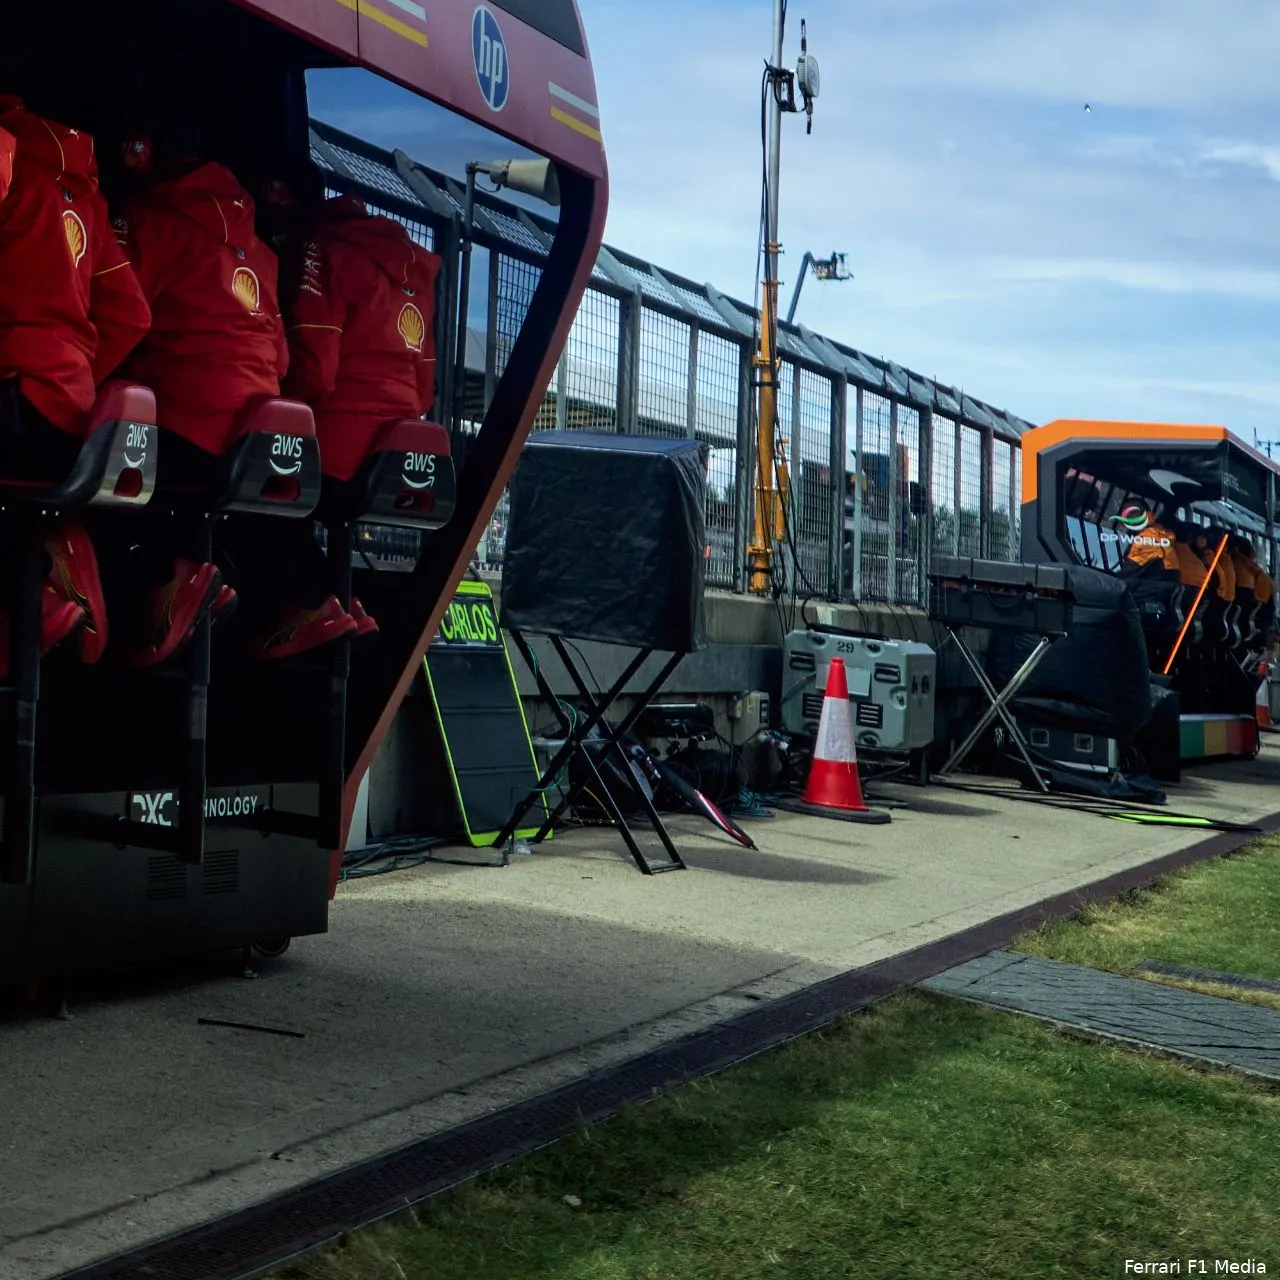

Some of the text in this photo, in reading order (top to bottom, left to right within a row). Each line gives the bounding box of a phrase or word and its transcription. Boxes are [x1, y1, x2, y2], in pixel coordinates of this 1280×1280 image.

[478, 8, 504, 108] hp
[272, 434, 303, 458] aws
[404, 451, 436, 473] aws
[1100, 533, 1171, 548] DP WORLD
[441, 603, 497, 641] CARLOS
[837, 641, 854, 653] 29
